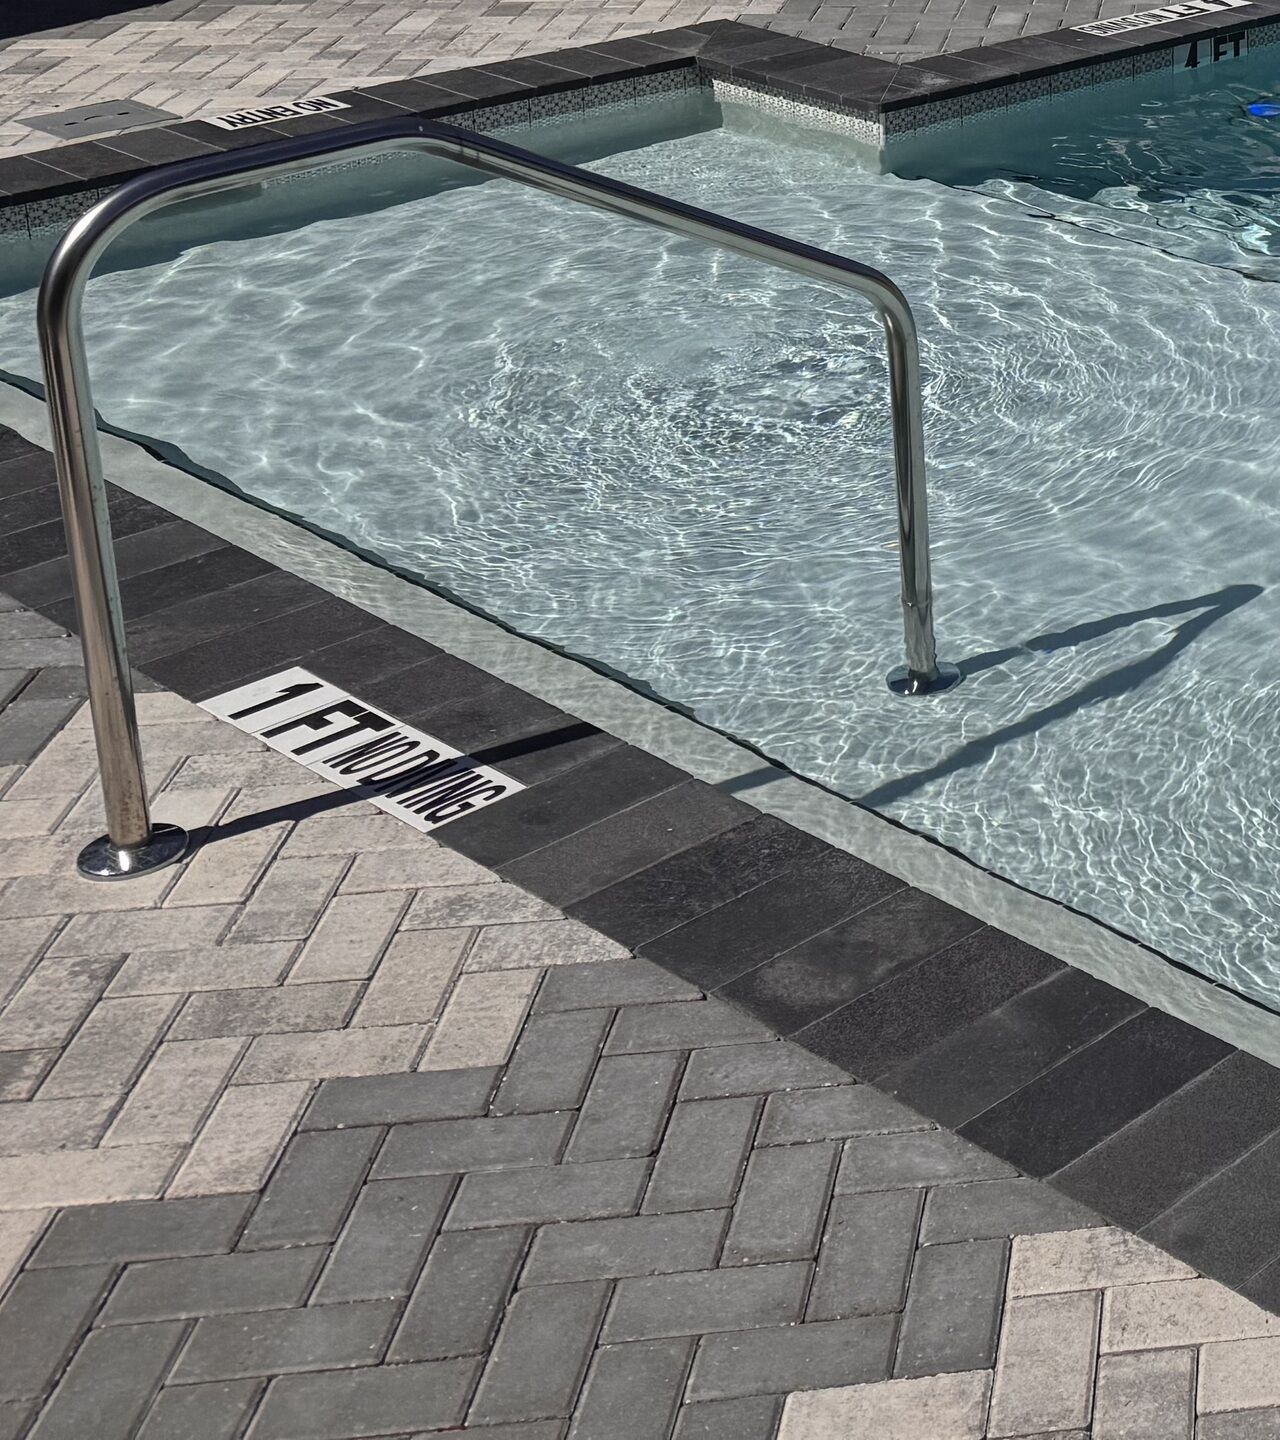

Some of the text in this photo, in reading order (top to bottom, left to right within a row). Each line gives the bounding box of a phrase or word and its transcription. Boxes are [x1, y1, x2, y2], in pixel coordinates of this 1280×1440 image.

[1160, 4, 1211, 18] FT
[1213, 31, 1246, 62] FT
[217, 98, 339, 128] NO ENTRY
[228, 682, 507, 824] 1 FT NO DIVING
